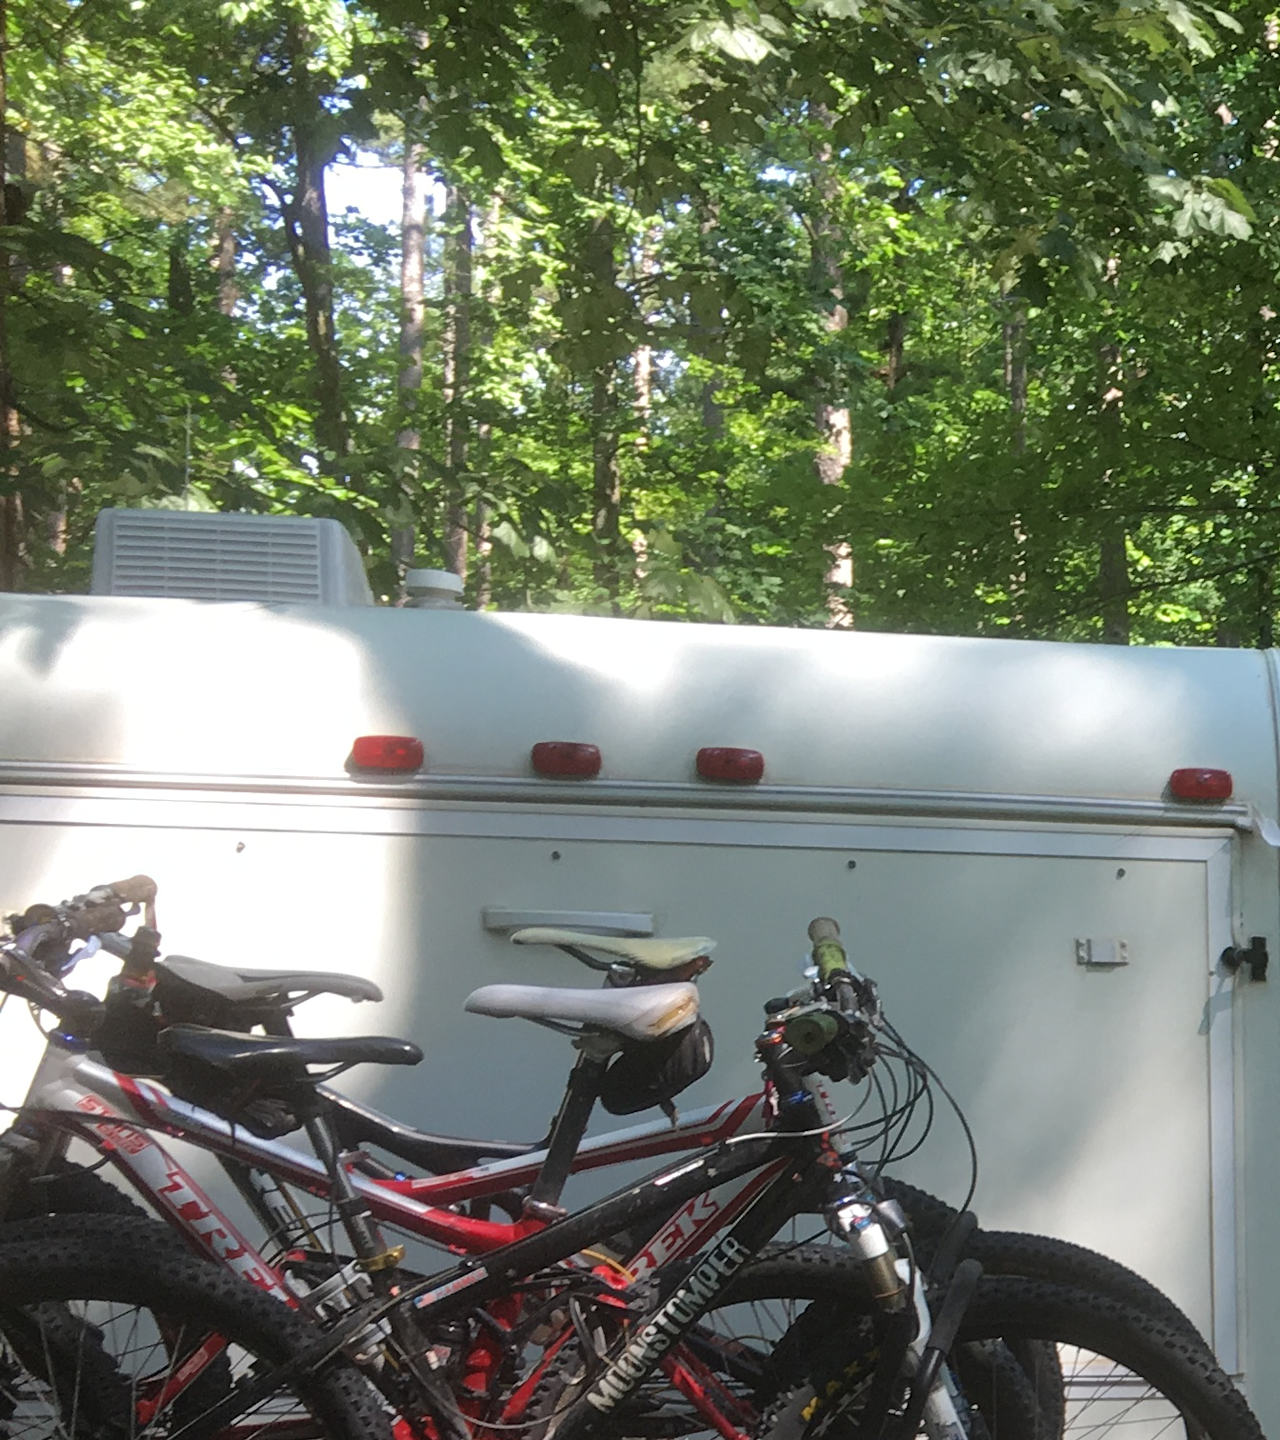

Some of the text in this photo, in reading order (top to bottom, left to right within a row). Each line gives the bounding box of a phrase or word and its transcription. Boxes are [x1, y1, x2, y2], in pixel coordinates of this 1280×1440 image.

[158, 1168, 289, 1302] TRE
[632, 1190, 719, 1281] REK
[587, 1236, 751, 1413] MOONSTOMPER
